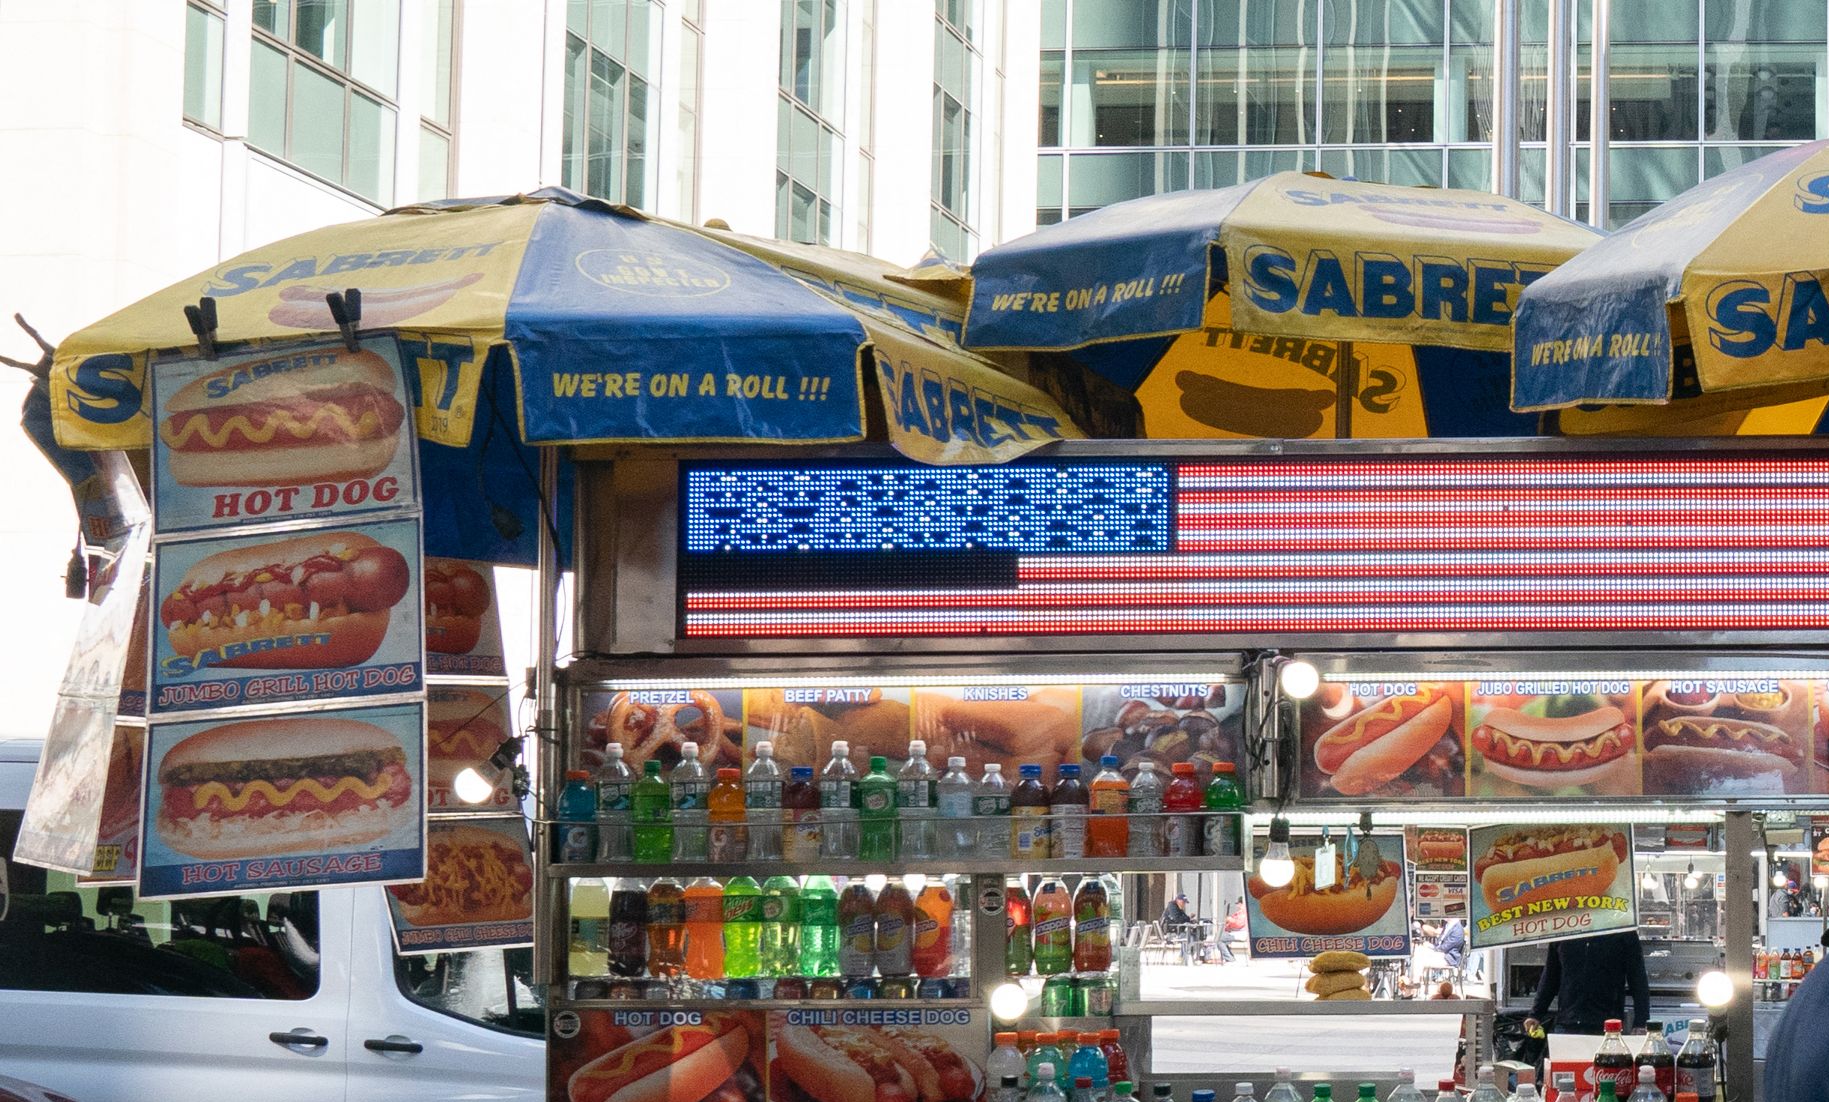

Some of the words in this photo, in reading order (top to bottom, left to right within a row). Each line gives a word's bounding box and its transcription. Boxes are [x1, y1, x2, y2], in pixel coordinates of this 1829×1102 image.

[202, 241, 500, 298] SABRETT
[991, 290, 1060, 315] WE'RE
[1065, 287, 1092, 311] ON
[1093, 285, 1109, 305] A
[1111, 279, 1156, 304] ROLL
[1530, 340, 1571, 367] WE'RE
[1572, 339, 1588, 362] ON
[1587, 333, 1604, 358] A
[1610, 332, 1651, 357] ROLL
[207, 353, 337, 399] SABRETT
[552, 371, 641, 398] WE'RE
[649, 372, 689, 398] ON
[698, 373, 718, 397] A
[725, 373, 790, 400] ROLL
[211, 486, 300, 518] HOT
[310, 476, 400, 508] DOG
[158, 631, 333, 678] SABRETT
[159, 680, 240, 706] JUMBO
[245, 675, 312, 698] GRILL
[314, 672, 360, 693] HOT
[363, 665, 415, 689] DOG
[783, 687, 823, 703] BEEF
[827, 687, 873, 704] PATTY
[964, 686, 1029, 702] KNISHES
[1120, 683, 1209, 698] CHESTNUTS
[1348, 681, 1383, 697] HOT
[1384, 681, 1418, 697] DOG
[1477, 680, 1507, 697] JUBO
[1509, 680, 1569, 697] GRILLED
[1570, 680, 1599, 696] HOT
[1600, 680, 1631, 696] DOG
[1671, 680, 1705, 694] HOT
[1706, 679, 1779, 694] SAUSAGE
[628, 689, 696, 706] PRETZEL
[182, 862, 241, 885] HOT
[246, 853, 383, 881] SAUSAGE
[1495, 865, 1600, 903] SABRETT
[1476, 904, 1524, 933] BEST
[1527, 896, 1571, 915] NEW
[1575, 895, 1629, 912] YORK
[1512, 918, 1548, 937] HOT
[1552, 912, 1593, 930] DOG
[402, 929, 442, 945] JUMBO
[444, 926, 473, 942] CHILI
[474, 924, 517, 940] CHEESE
[1255, 937, 1297, 953] CHILI
[1301, 937, 1365, 952] CHEESE
[1367, 934, 1405, 951] DOG
[614, 1010, 657, 1027] HOT
[659, 1010, 703, 1027] DOG
[786, 1009, 841, 1027] CHILI
[843, 1009, 921, 1026] CHEESE
[924, 1008, 970, 1026] DOG
[1594, 1067, 1633, 1087] Coca-Cola
